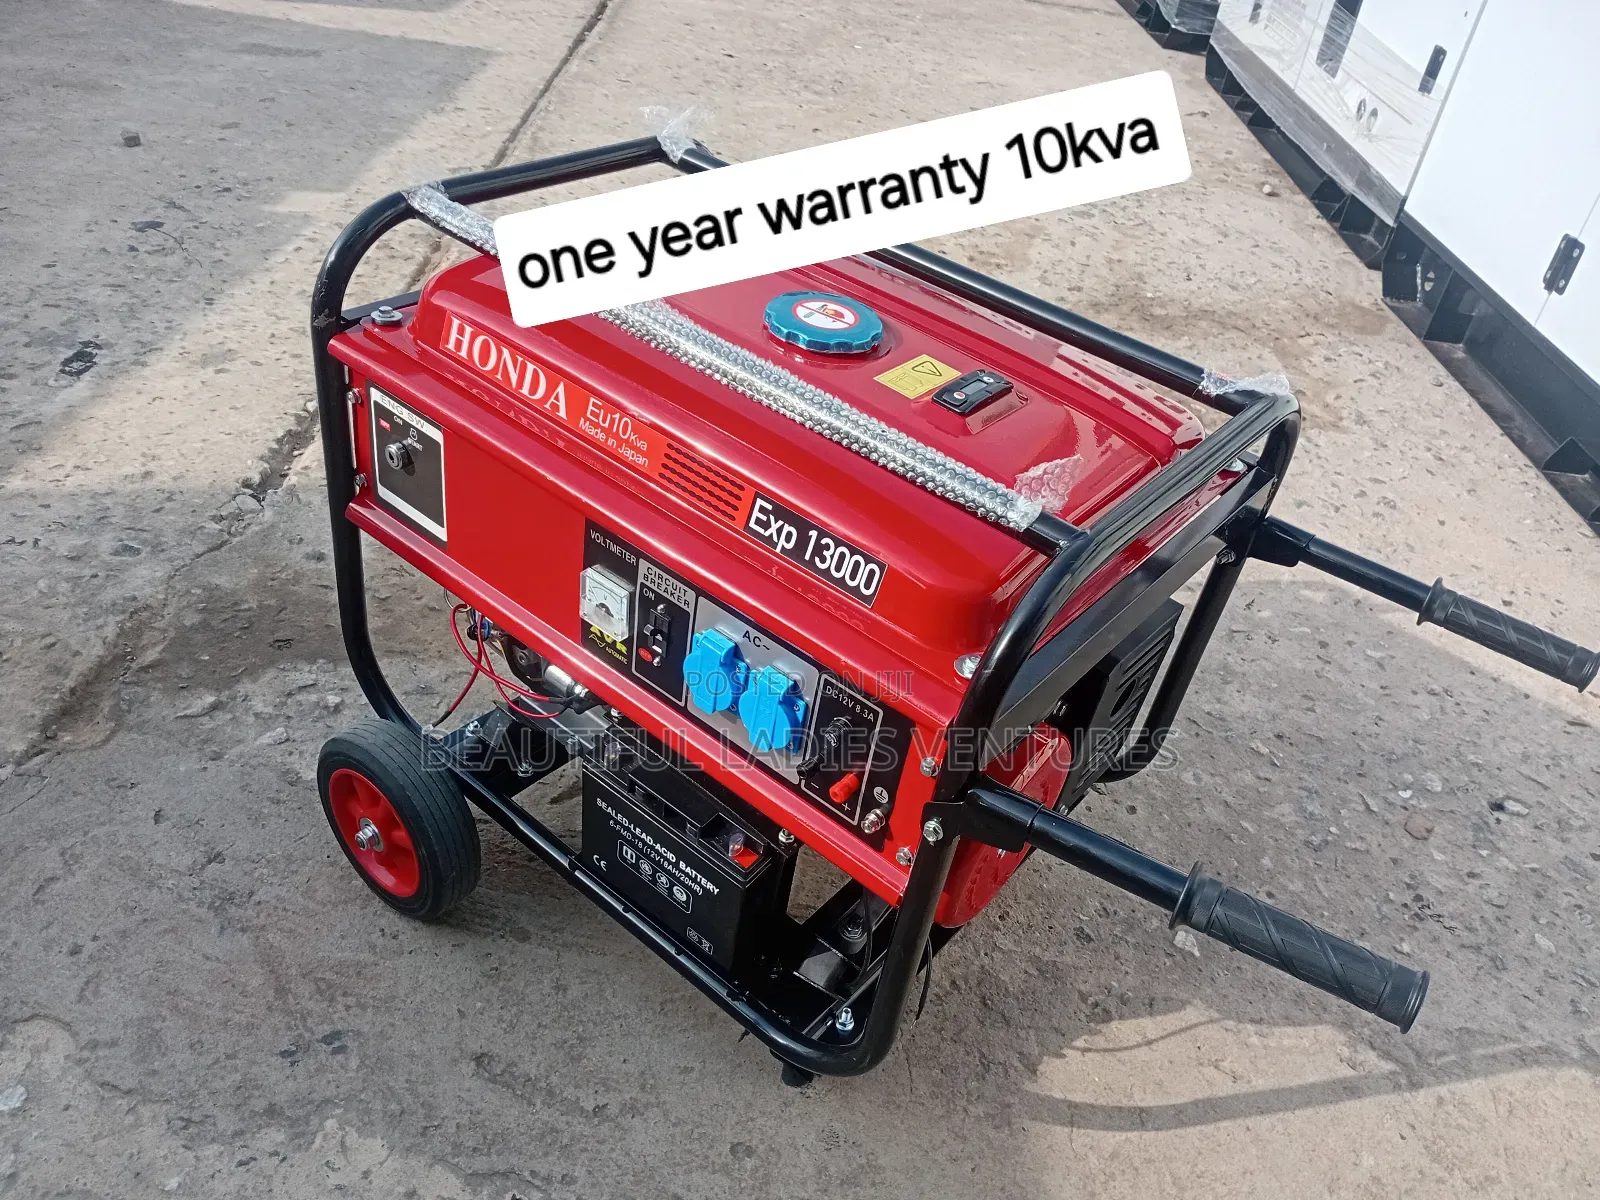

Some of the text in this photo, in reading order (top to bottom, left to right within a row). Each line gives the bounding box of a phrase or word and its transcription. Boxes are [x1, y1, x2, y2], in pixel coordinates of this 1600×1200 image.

[445, 316, 569, 421] HONDA
[380, 394, 404, 416] ENG
[579, 417, 649, 467] Made in Japan
[586, 397, 648, 452] Eu10Kva
[590, 528, 637, 566] VOLTMETER
[749, 498, 881, 596] Exp 13000
[643, 573, 690, 609] BREAKER
[643, 588, 655, 601] ON
[646, 566, 688, 597] CIRCUIT
[825, 685, 875, 723] DC12V 8.3A
[596, 797, 720, 896] SEALED-LEAD-ACID BATTERY
